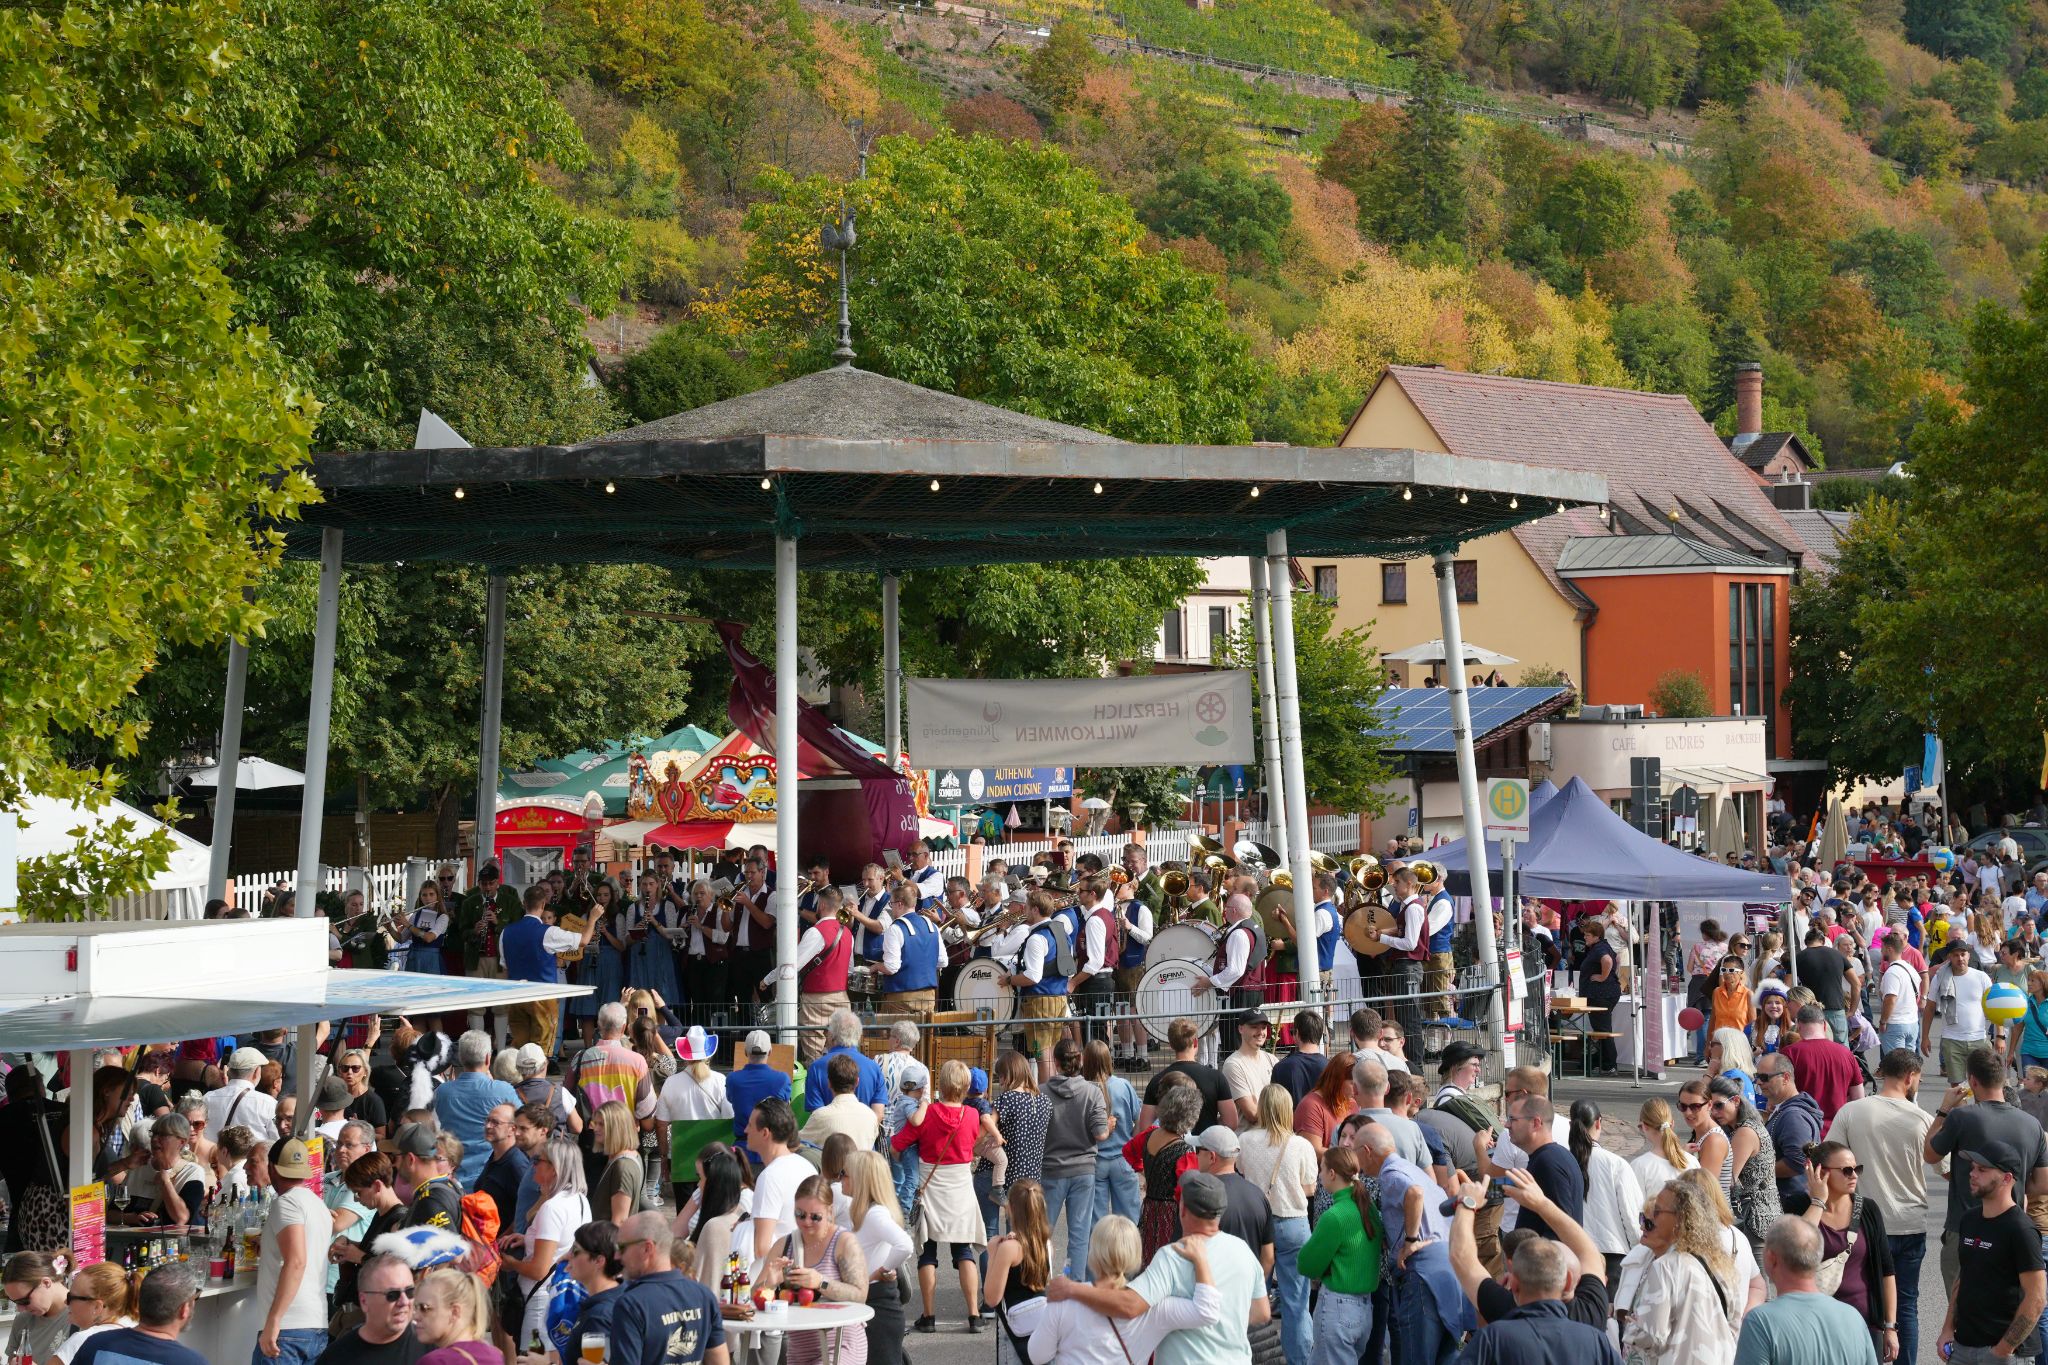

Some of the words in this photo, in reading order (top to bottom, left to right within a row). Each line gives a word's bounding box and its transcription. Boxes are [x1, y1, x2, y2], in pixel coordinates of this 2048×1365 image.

[1612, 734, 1636, 751] CAFÉ
[1665, 735, 1705, 750] ENDRES
[1725, 732, 1761, 745] BÄCKEREI
[994, 768, 1035, 781] AUTHENTIC
[986, 784, 1012, 798] INDIAN
[1013, 782, 1042, 796] CUISINE
[1500, 788, 1515, 812] H
[661, 1307, 702, 1326] WEINGUT
